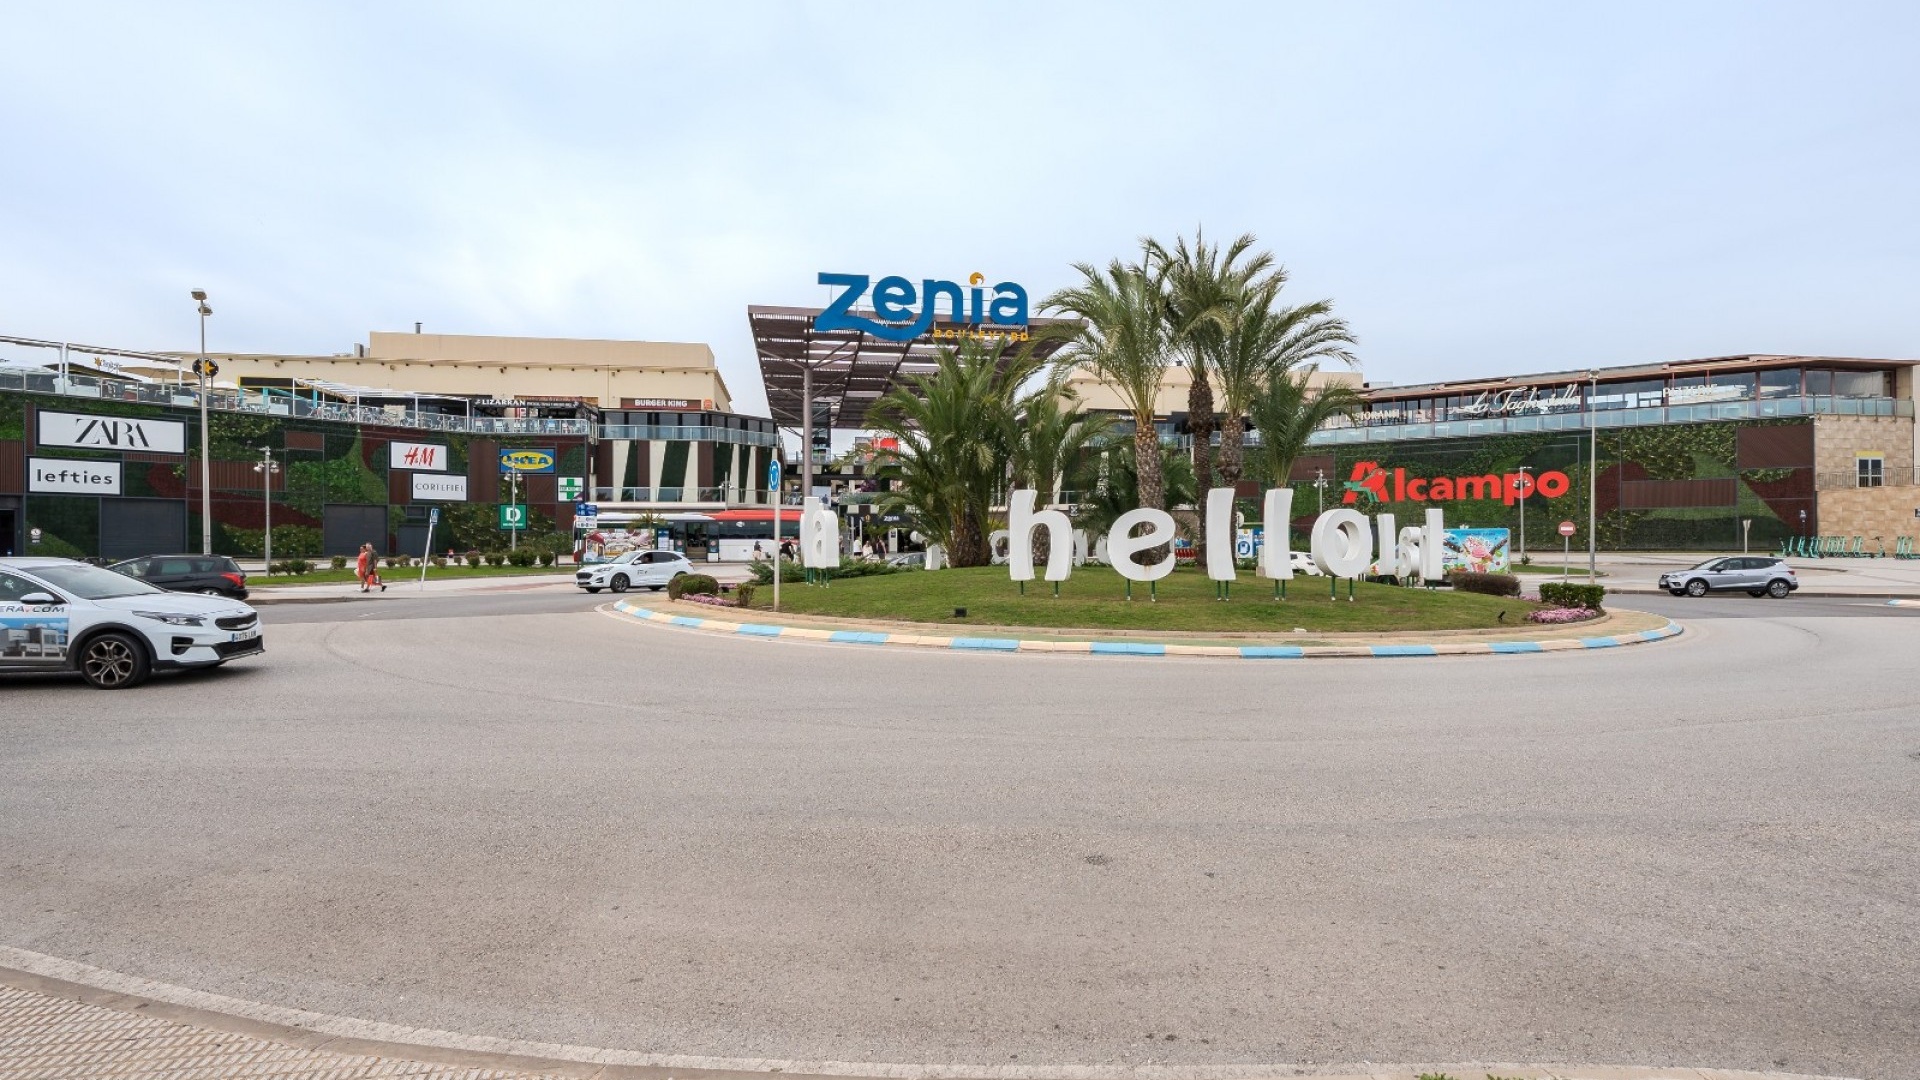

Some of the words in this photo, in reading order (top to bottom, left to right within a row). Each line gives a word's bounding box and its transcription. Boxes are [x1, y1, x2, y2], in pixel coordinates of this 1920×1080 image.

[934, 329, 1029, 342] BOULEVARD
[634, 399, 666, 407] BURGER
[667, 400, 688, 408] KING
[74, 418, 150, 447] ZARA
[403, 446, 435, 467] H&M
[36, 469, 113, 485] lefties
[1342, 461, 1569, 506] Alcampo
[505, 507, 521, 522] D
[1009, 488, 1371, 582] hello
